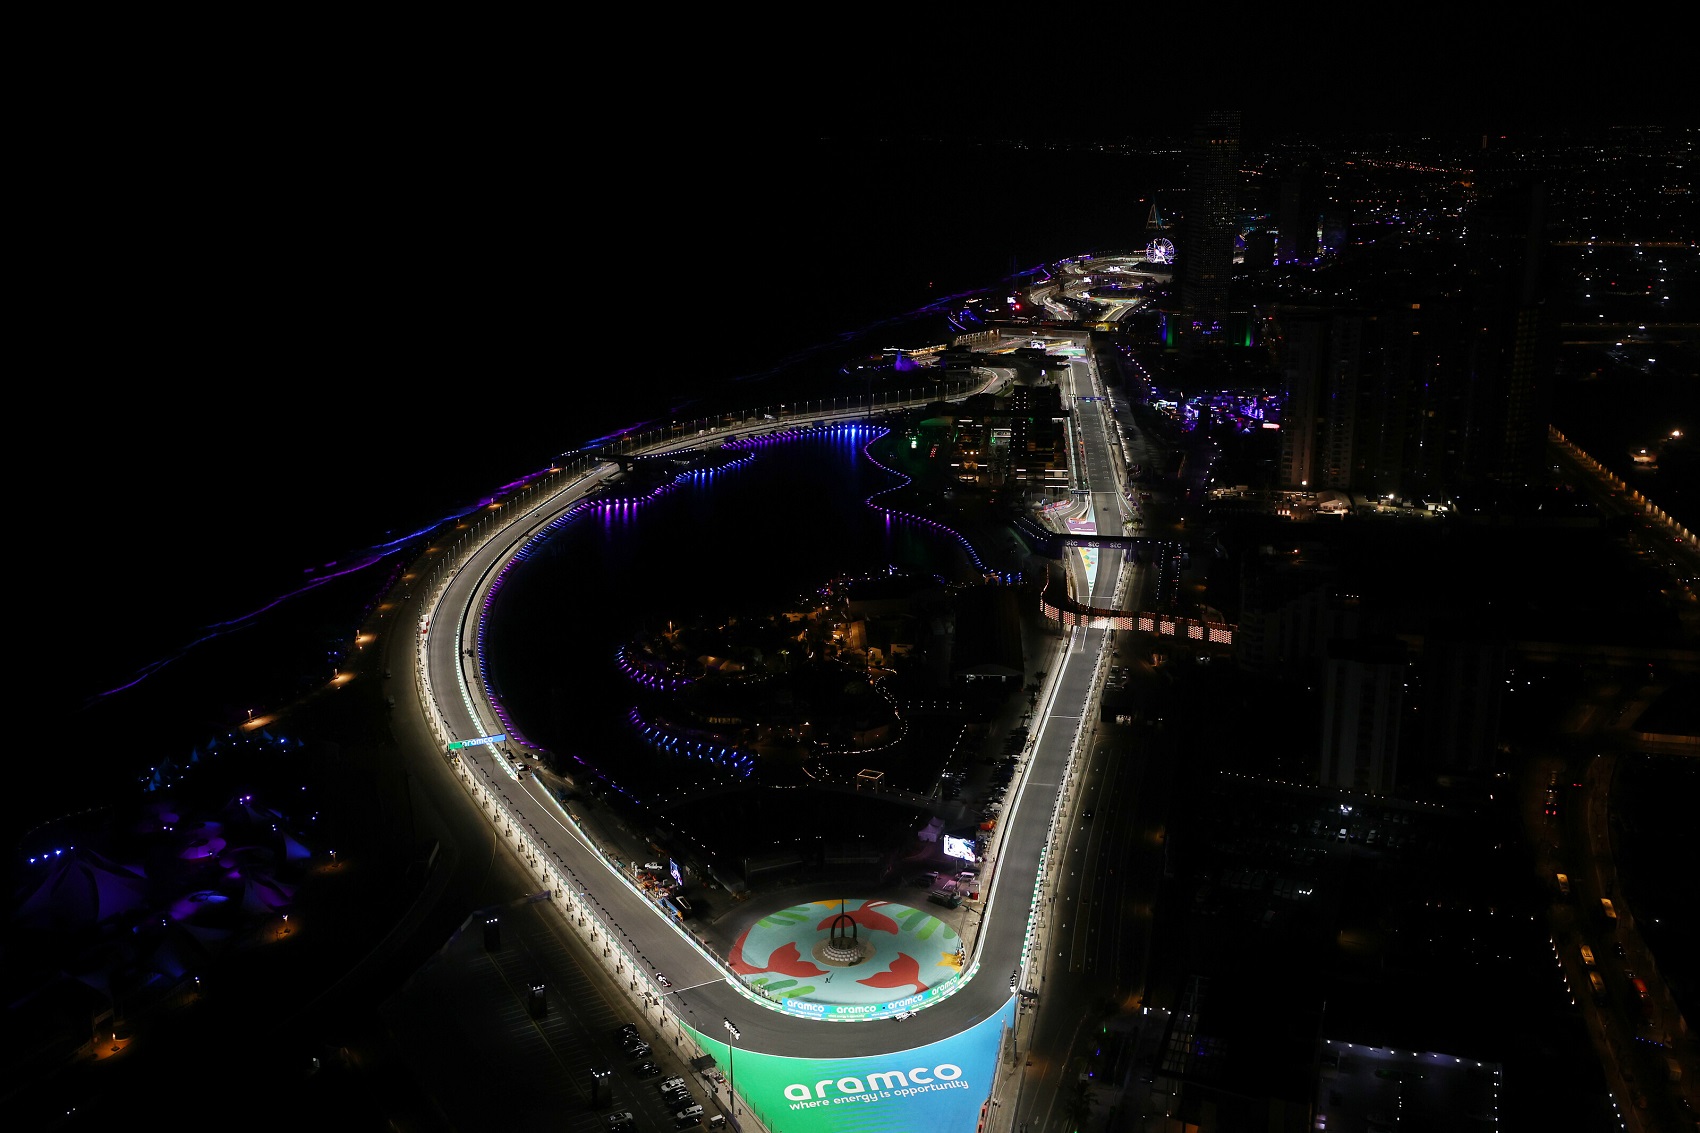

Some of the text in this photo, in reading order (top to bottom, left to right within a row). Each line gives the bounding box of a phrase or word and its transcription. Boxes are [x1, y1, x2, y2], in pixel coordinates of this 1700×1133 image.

[462, 737, 493, 747] aramco
[931, 976, 957, 995] aramco
[787, 1000, 825, 1012] aramco
[888, 995, 923, 1009] aramco
[836, 1005, 876, 1014] aramco
[784, 1063, 962, 1101] aramco
[789, 1079, 969, 1111] where energy is opportunity
